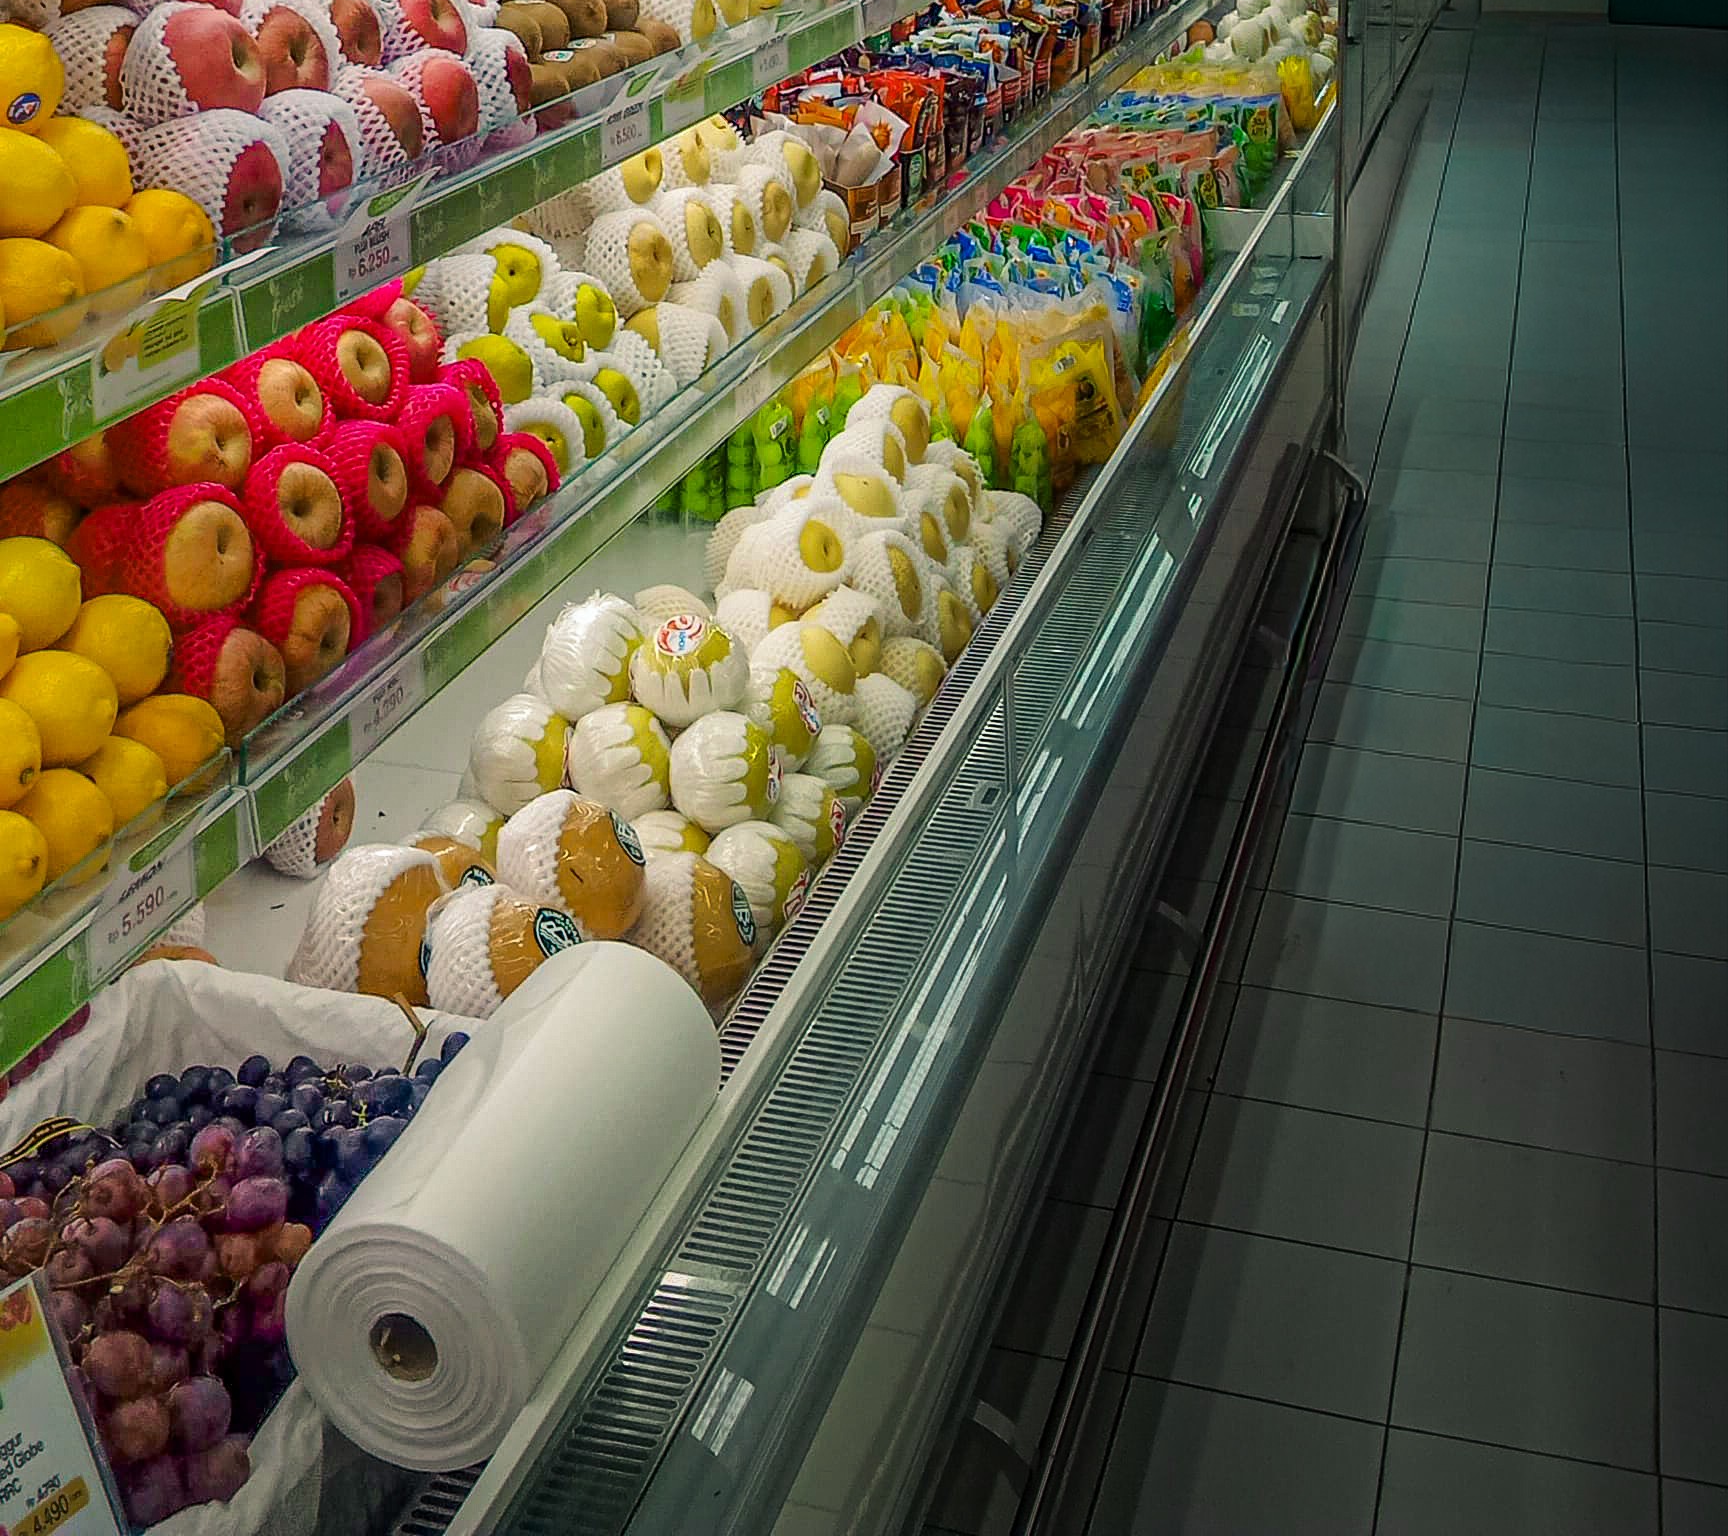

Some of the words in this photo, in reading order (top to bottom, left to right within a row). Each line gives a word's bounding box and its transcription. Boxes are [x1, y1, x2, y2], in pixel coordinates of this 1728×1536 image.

[357, 245, 391, 278] 6.250
[122, 885, 165, 937] 5.590
[33, 1493, 70, 1534] 4.490
